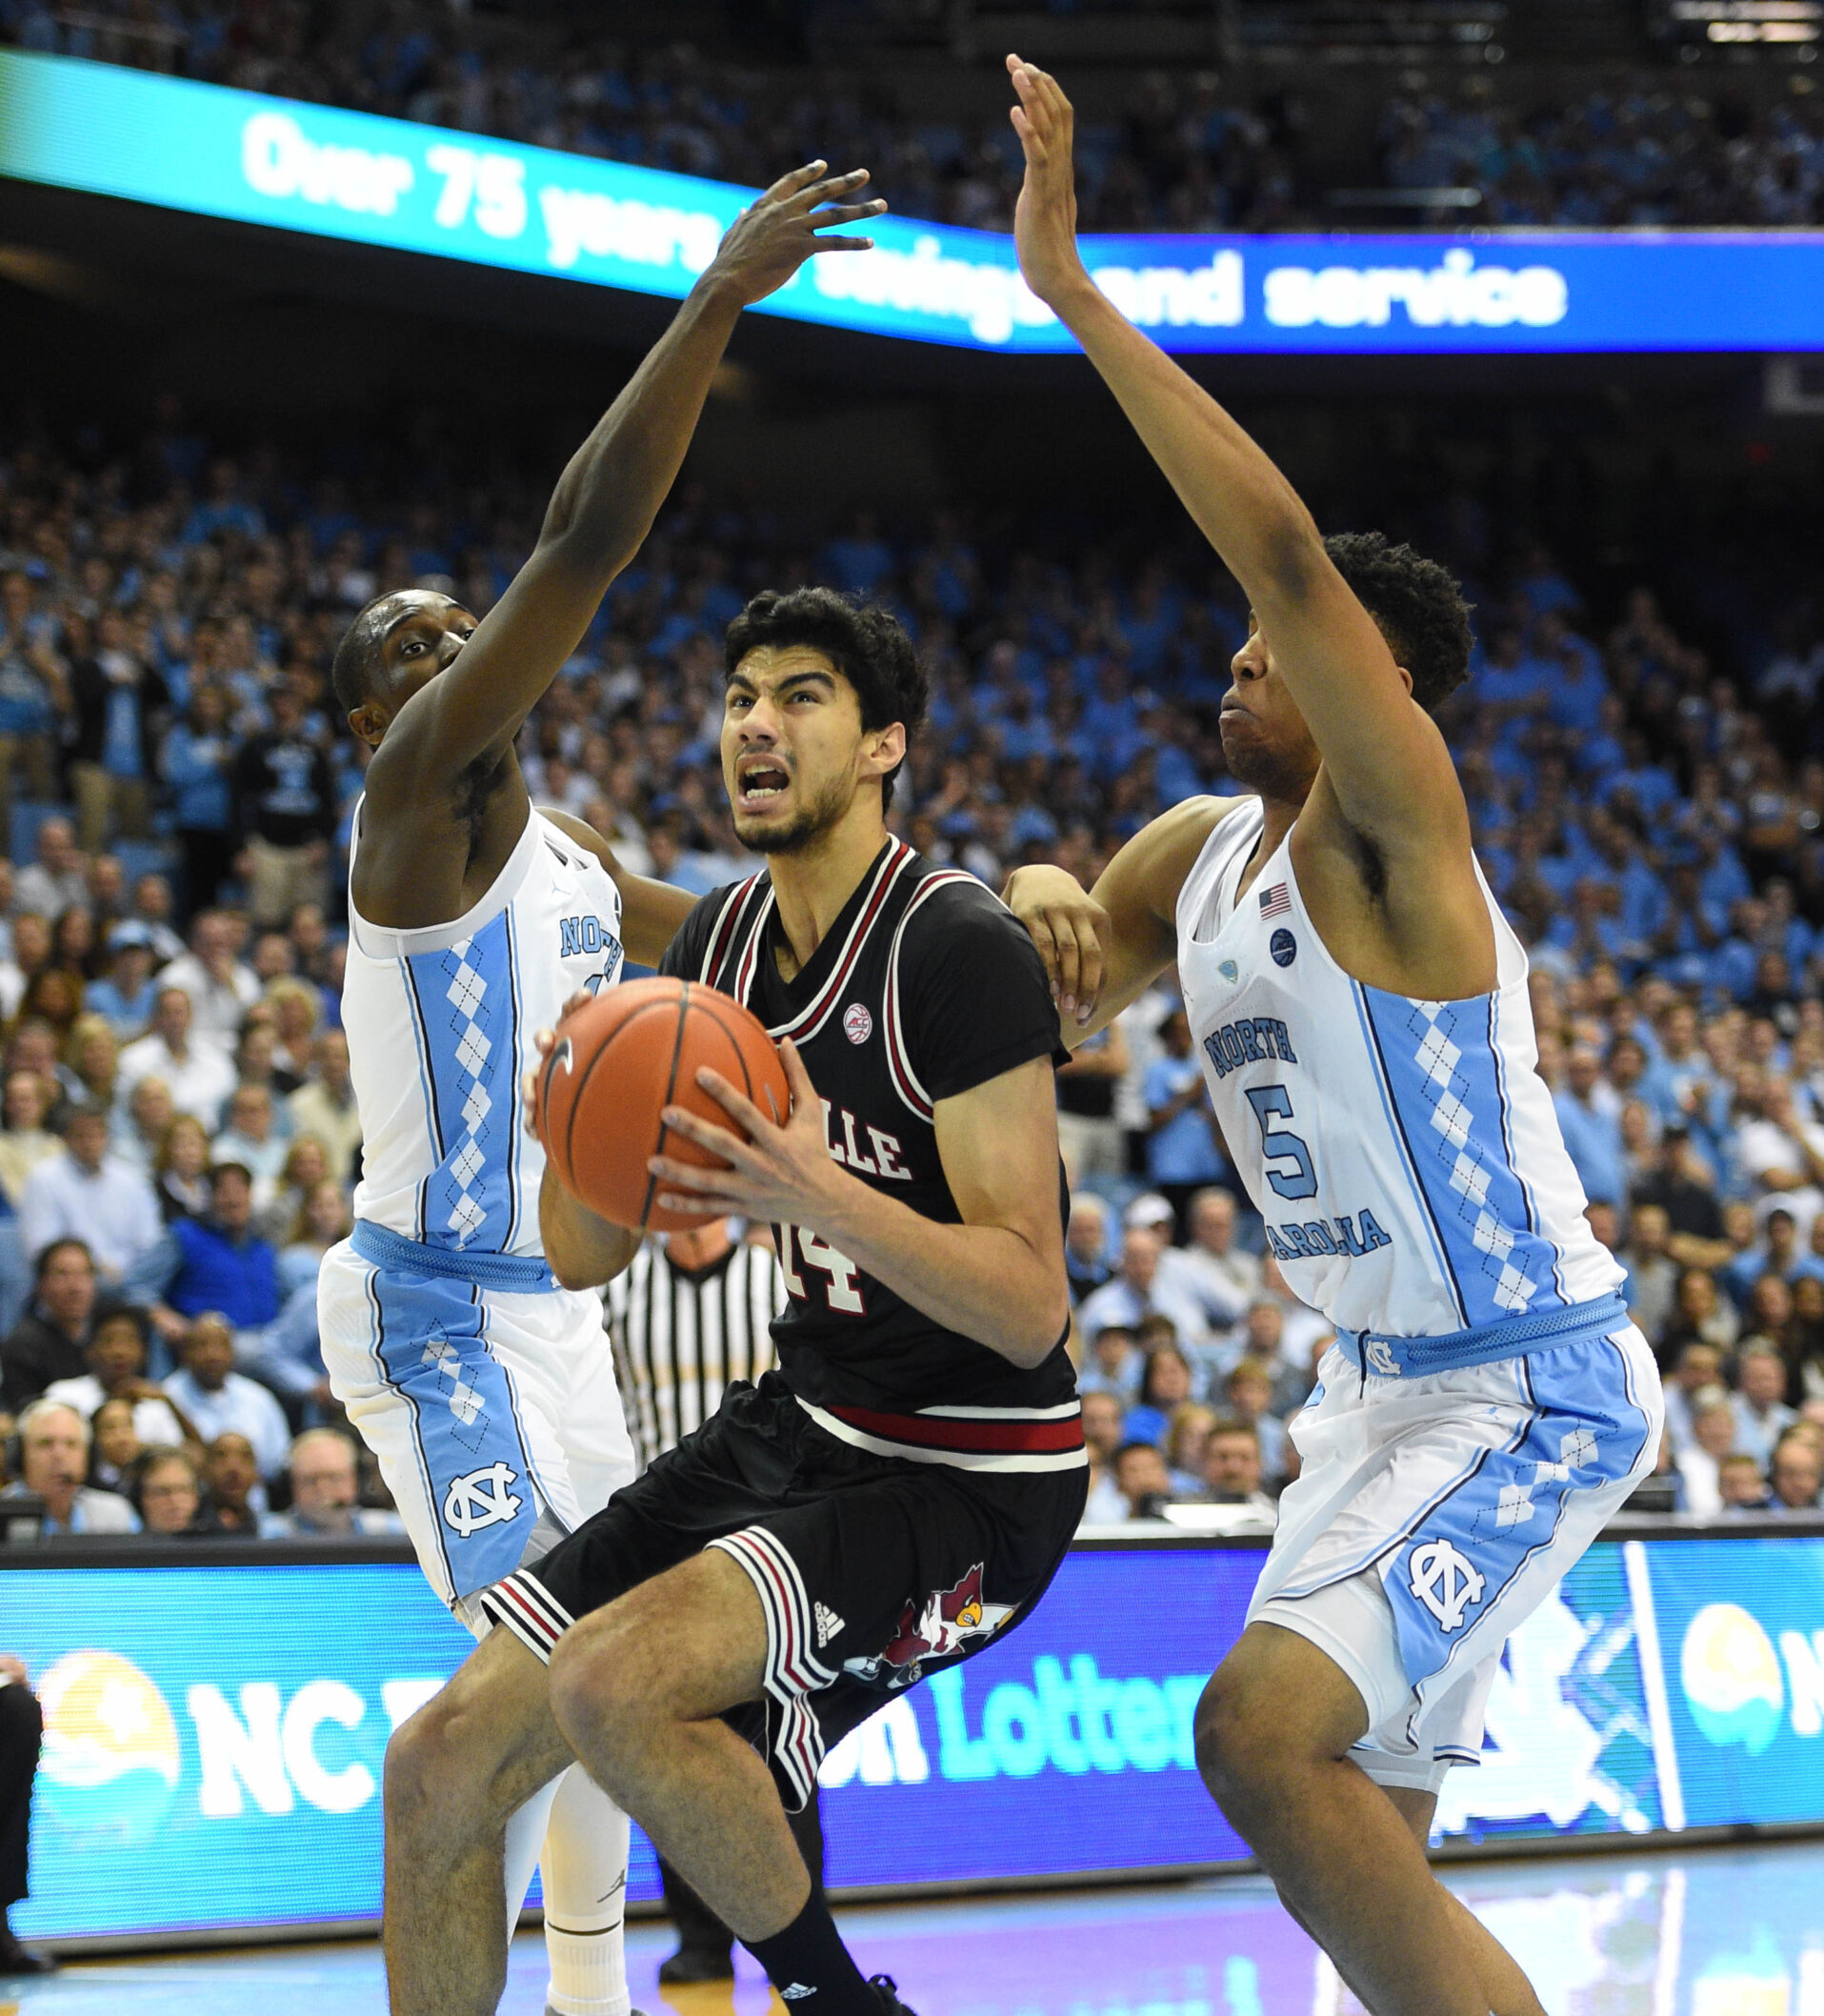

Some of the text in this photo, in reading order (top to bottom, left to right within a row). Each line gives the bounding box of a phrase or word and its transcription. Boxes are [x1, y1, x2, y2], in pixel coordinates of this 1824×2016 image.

[241, 111, 415, 217] Over
[426, 144, 528, 239] 75
[538, 186, 724, 272] years
[1263, 248, 1568, 329] service
[1204, 1017, 1298, 1079] NORTH
[1245, 1083, 1319, 1201] 5
[814, 1601, 828, 1648] adidas
[187, 1679, 376, 1819] NC
